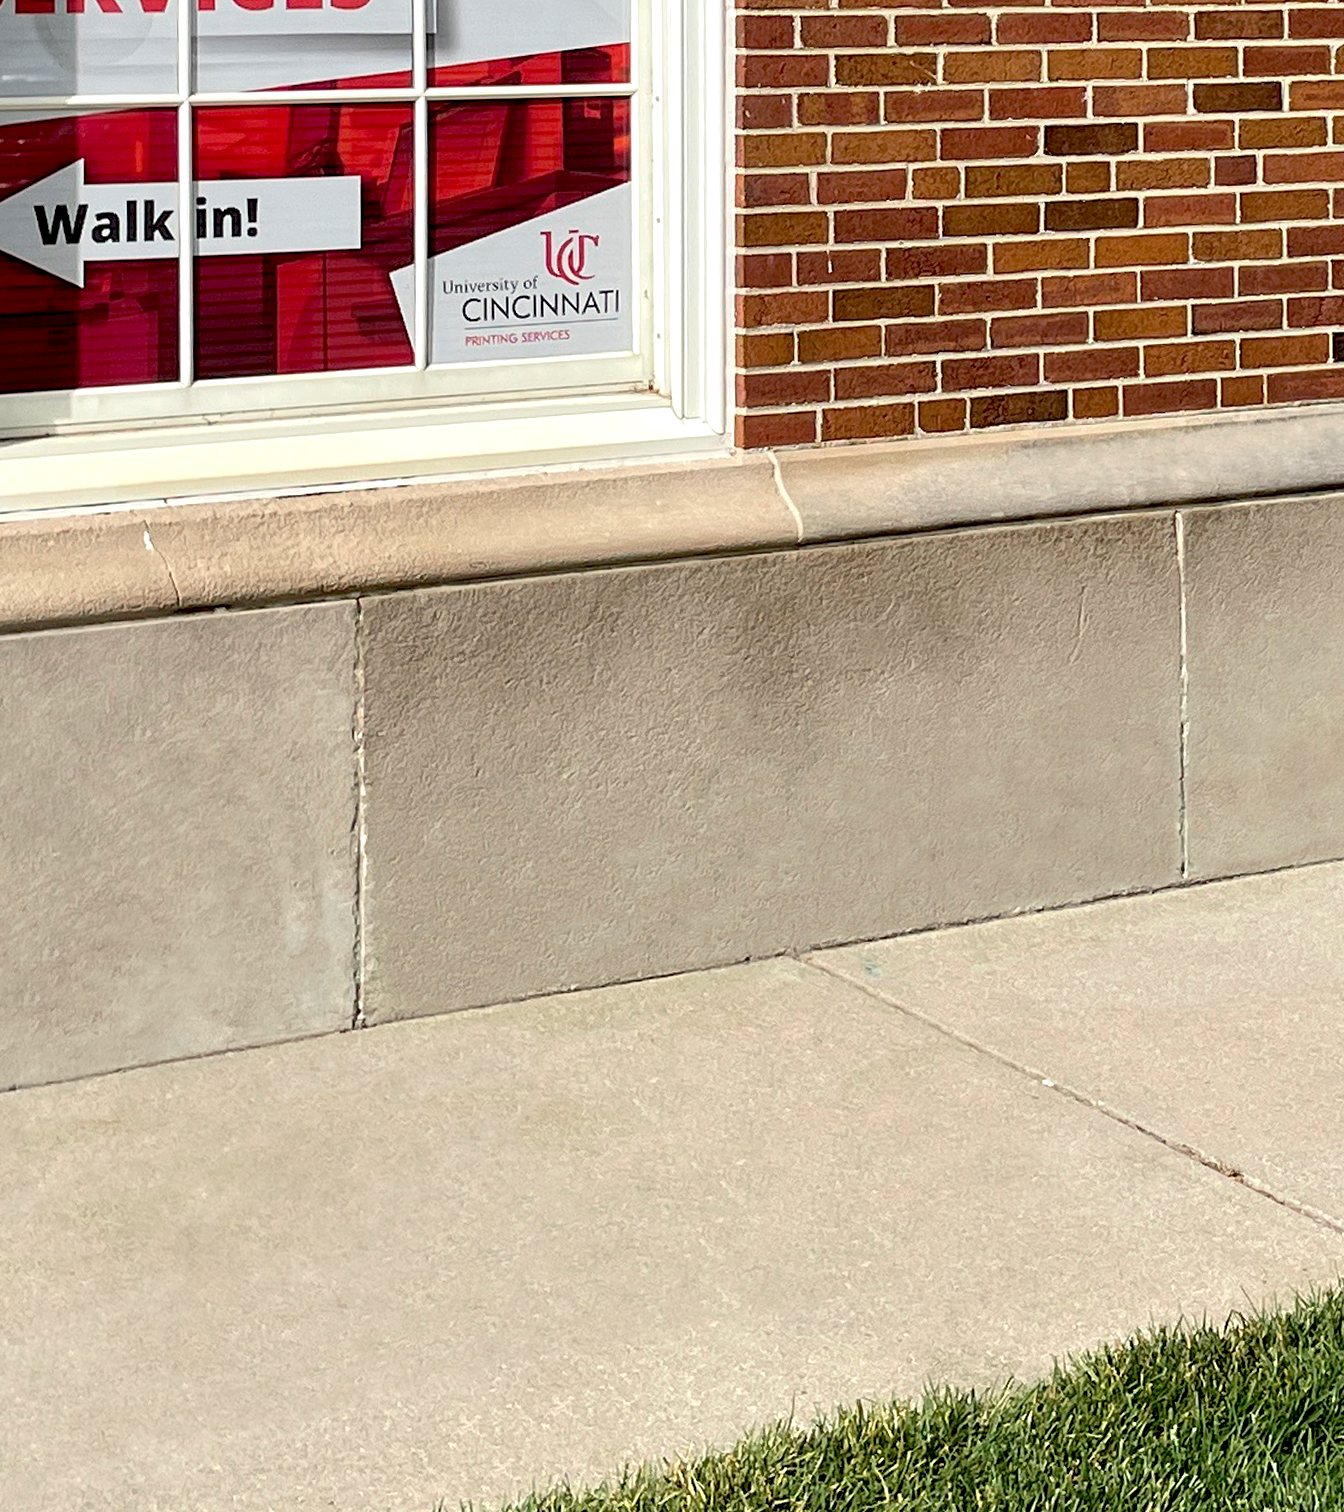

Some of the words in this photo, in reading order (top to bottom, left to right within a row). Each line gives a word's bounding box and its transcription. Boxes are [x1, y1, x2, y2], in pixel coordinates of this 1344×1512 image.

[33, 201, 176, 247] Walk
[194, 198, 260, 241] in!
[443, 278, 519, 294] University
[523, 276, 538, 289] of
[462, 289, 620, 322] CINCINNATI
[465, 334, 518, 346] PRINTING
[522, 330, 570, 342] SERVICES
